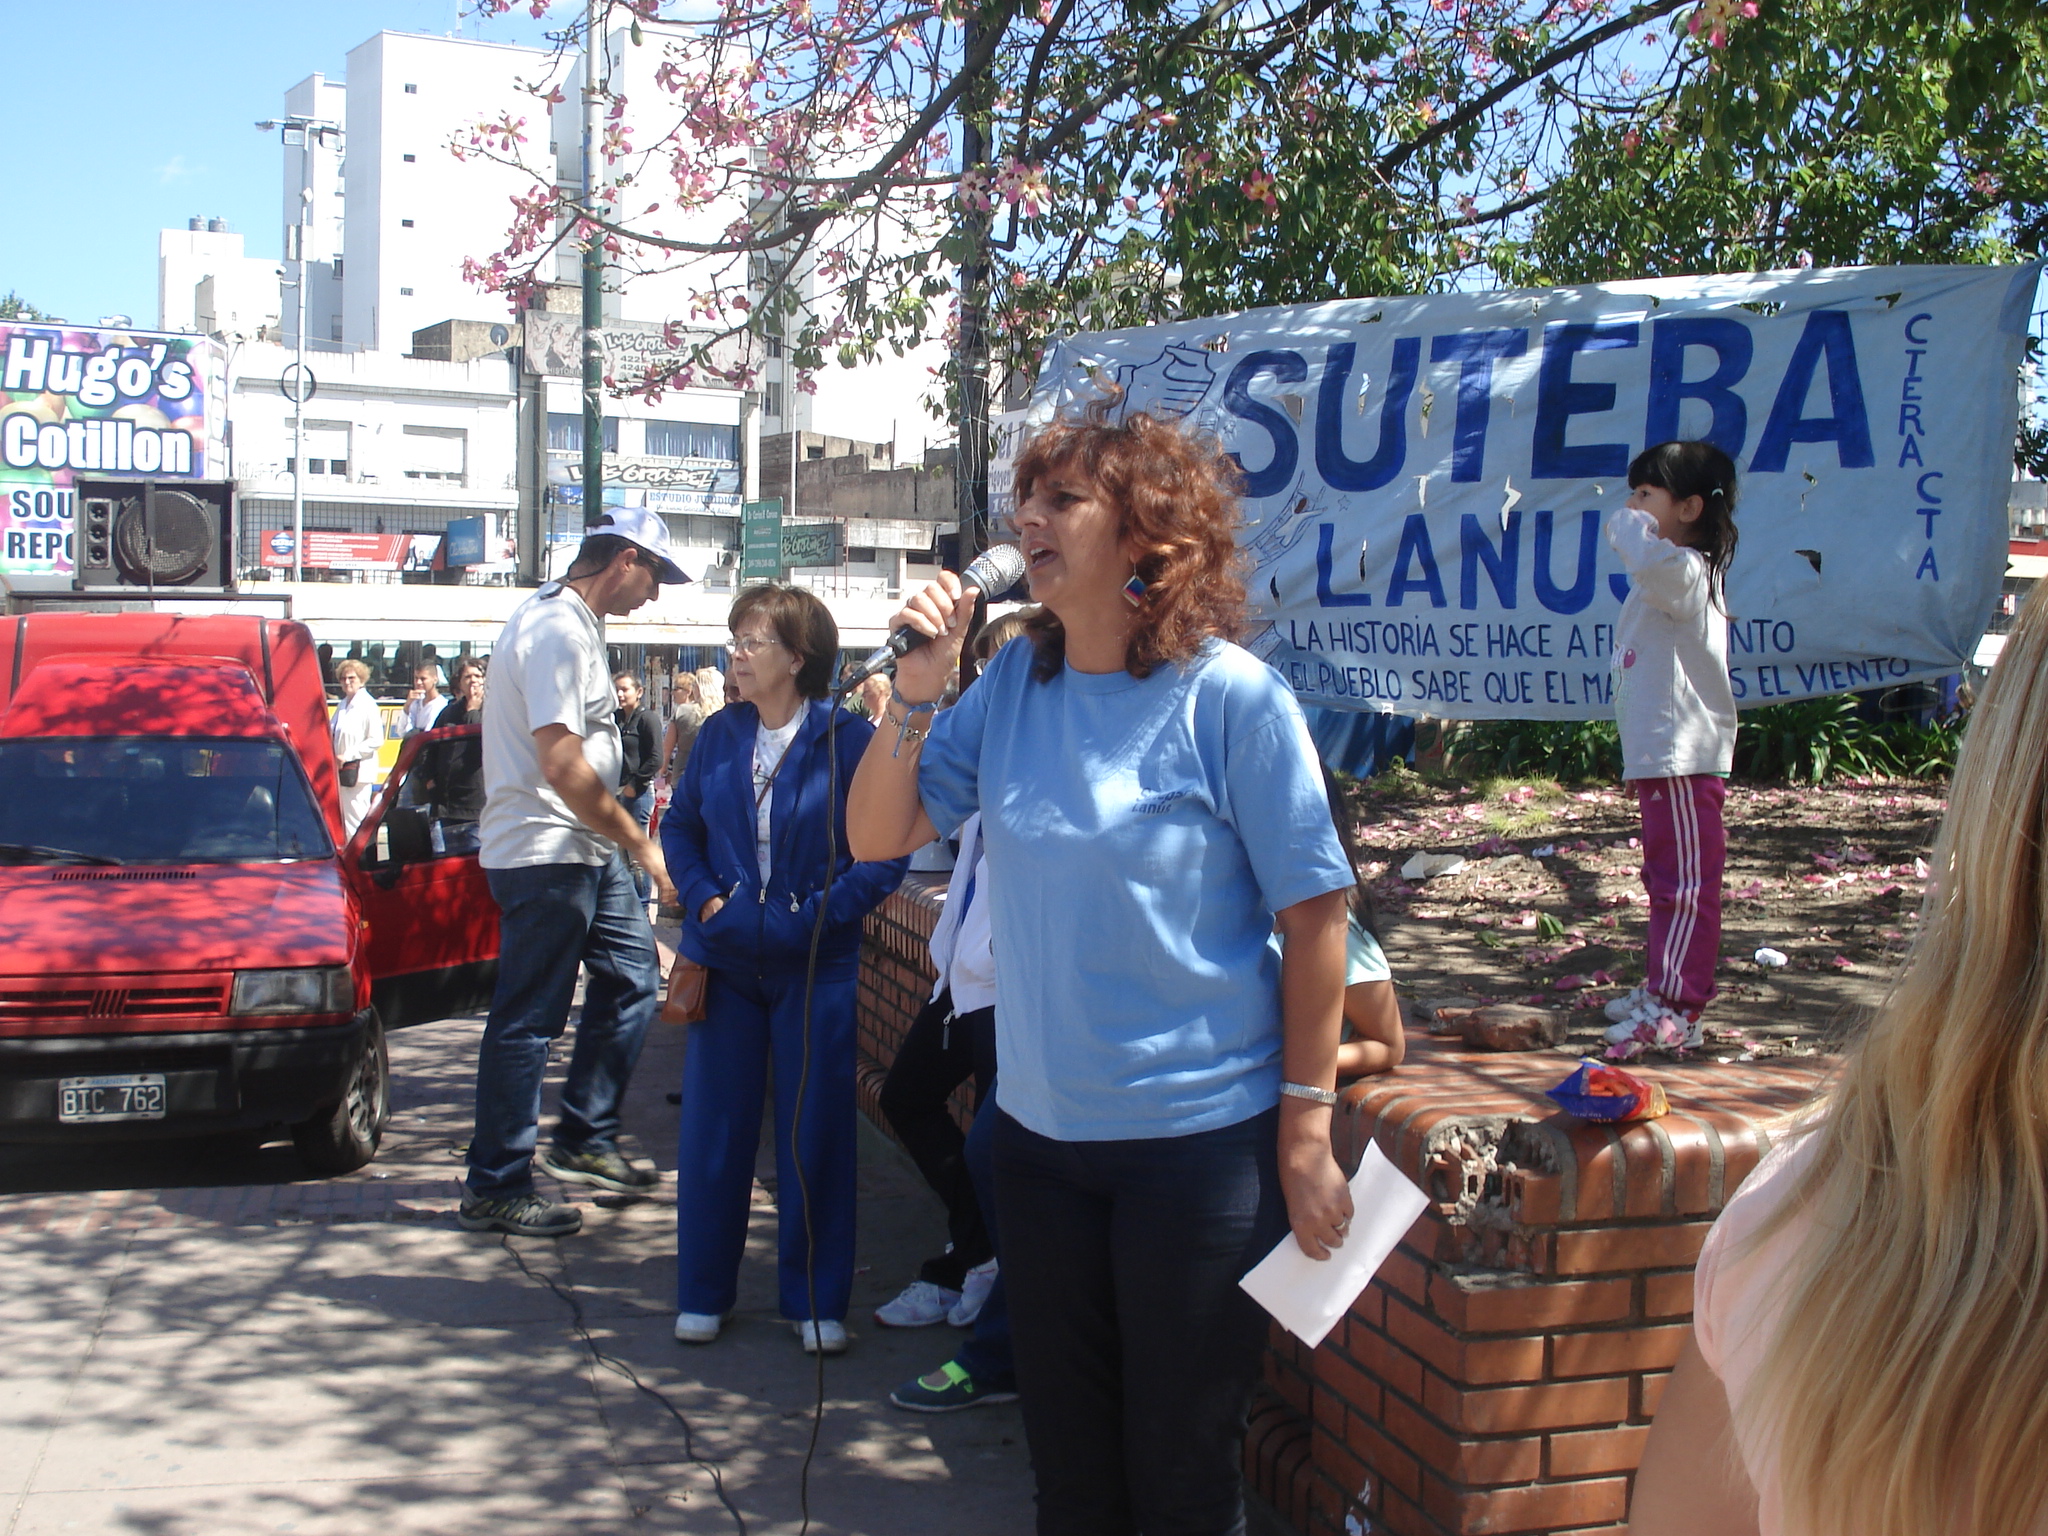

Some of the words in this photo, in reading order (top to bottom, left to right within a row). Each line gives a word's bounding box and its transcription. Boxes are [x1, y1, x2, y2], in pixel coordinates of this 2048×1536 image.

[4, 336, 193, 406] Hugo's
[1222, 309, 1876, 498] SUTEBA
[4, 415, 193, 474] Cotillon
[649, 491, 692, 503] ESTUDIO
[1316, 510, 1633, 615] LANU
[1290, 619, 1324, 652] LA
[1450, 624, 1479, 657] SE
[1486, 624, 1552, 658] HACE
[1566, 624, 1588, 658] A
[1729, 618, 1795, 653] NTO
[1290, 661, 1316, 692] EL
[1319, 665, 1402, 701] PUEBLO
[1412, 669, 1473, 703] SABE
[1484, 671, 1534, 704] QUE
[1545, 671, 1577, 704] EL
[1758, 665, 1791, 697] EL
[1794, 657, 1910, 693] VIENTO
[63, 1088, 105, 1115] BIC
[119, 1085, 161, 1112] 762
